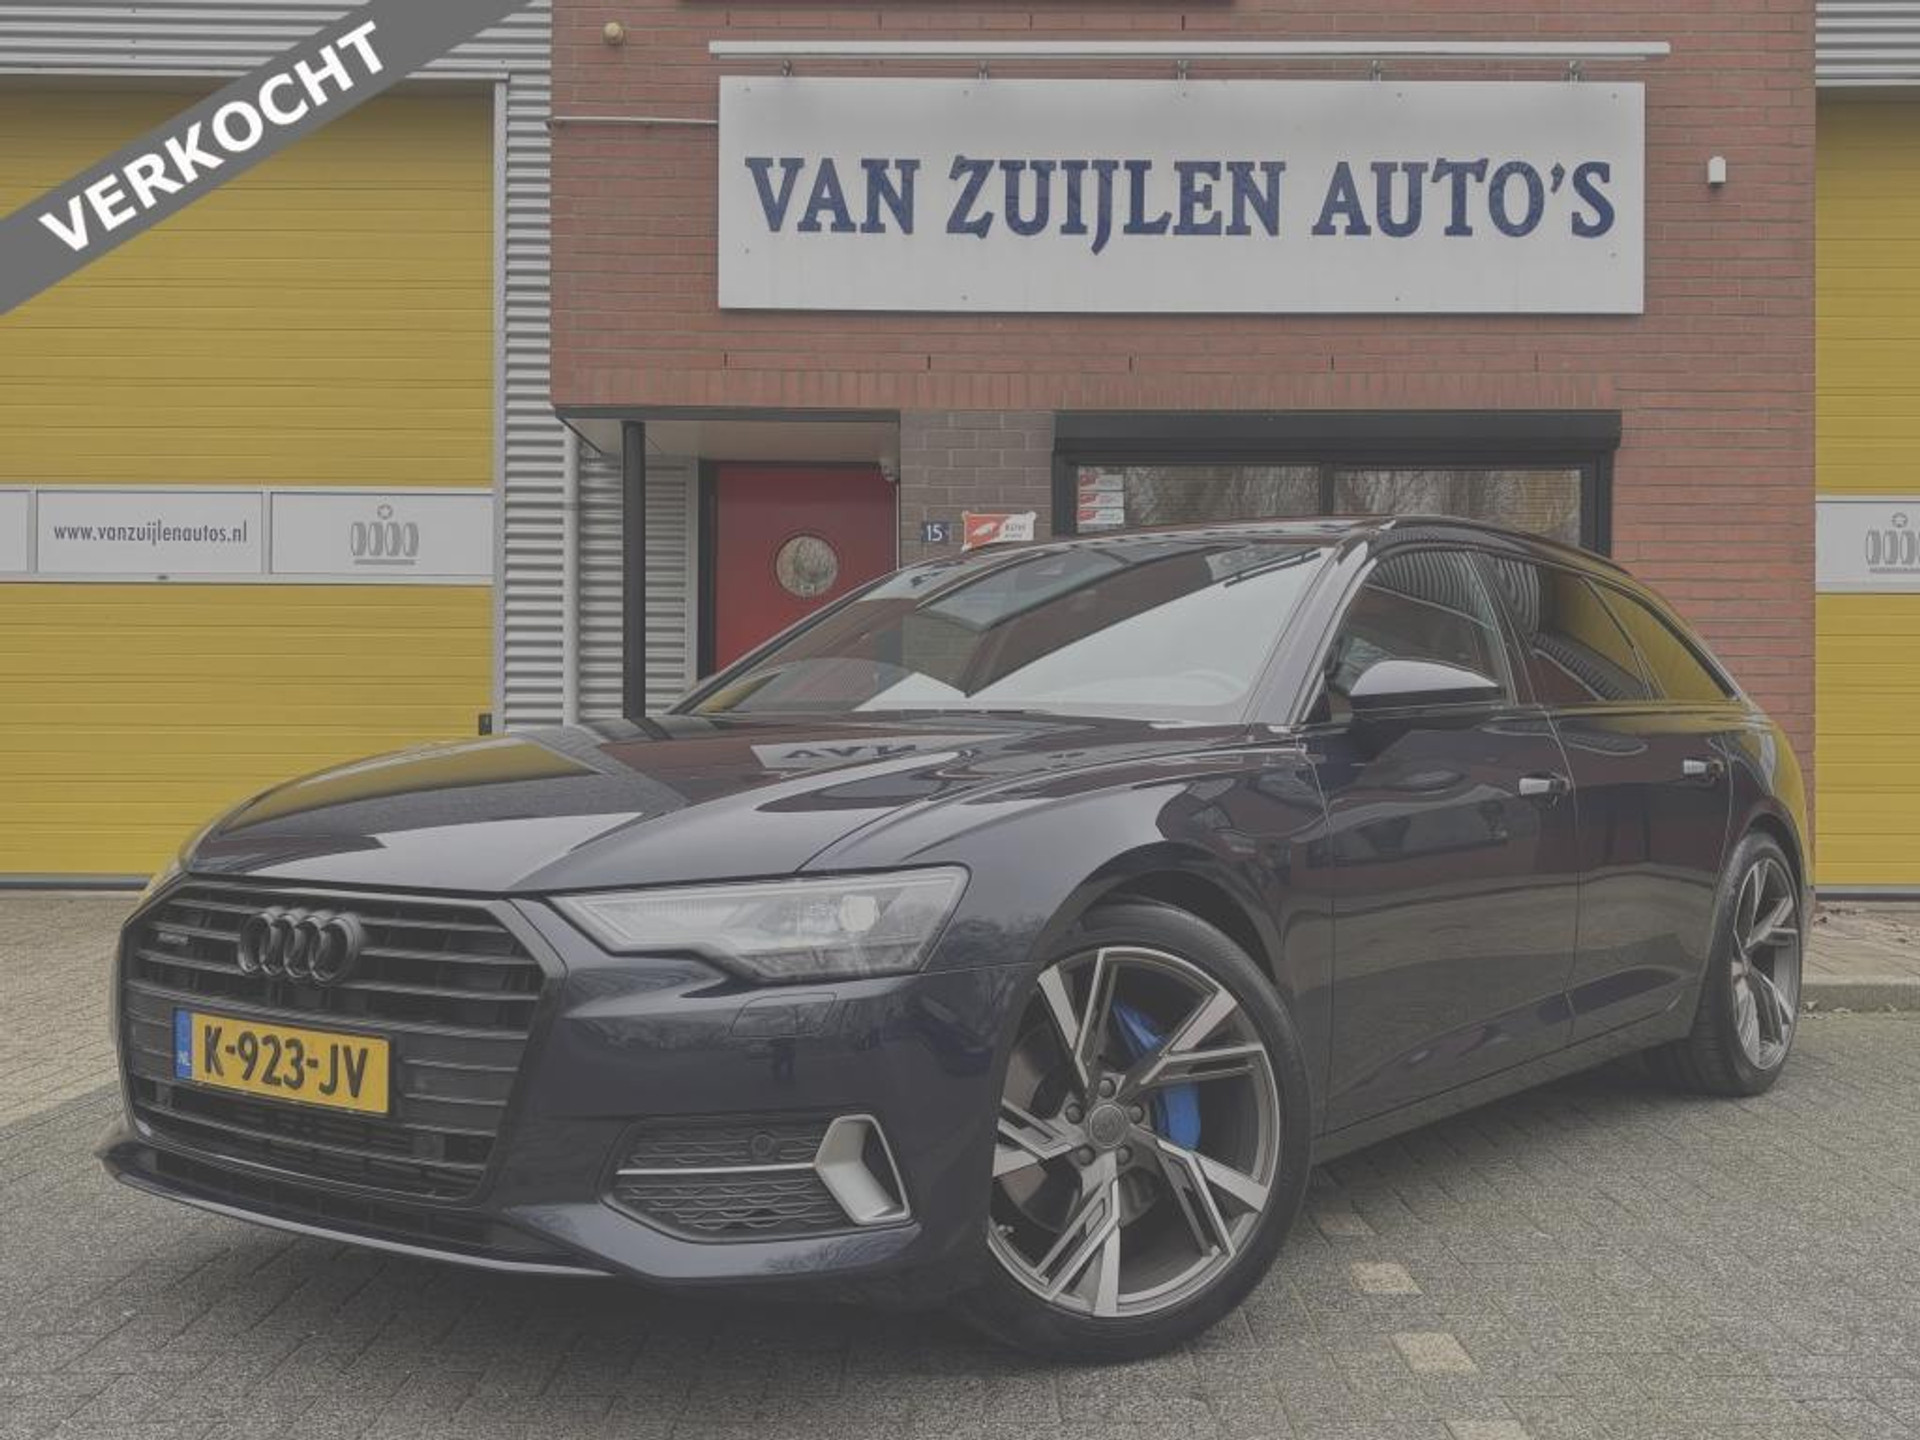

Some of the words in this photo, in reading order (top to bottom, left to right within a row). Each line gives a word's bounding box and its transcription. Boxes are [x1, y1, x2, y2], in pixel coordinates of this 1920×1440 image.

[744, 157, 921, 236] VAN
[946, 155, 1287, 255] ZUIJLEN
[1311, 157, 1616, 239] AUTO'S
[53, 519, 248, 546] www.vanzuijlenautos.nl
[926, 524, 943, 541] 15
[204, 1025, 368, 1098] K-923-JV
